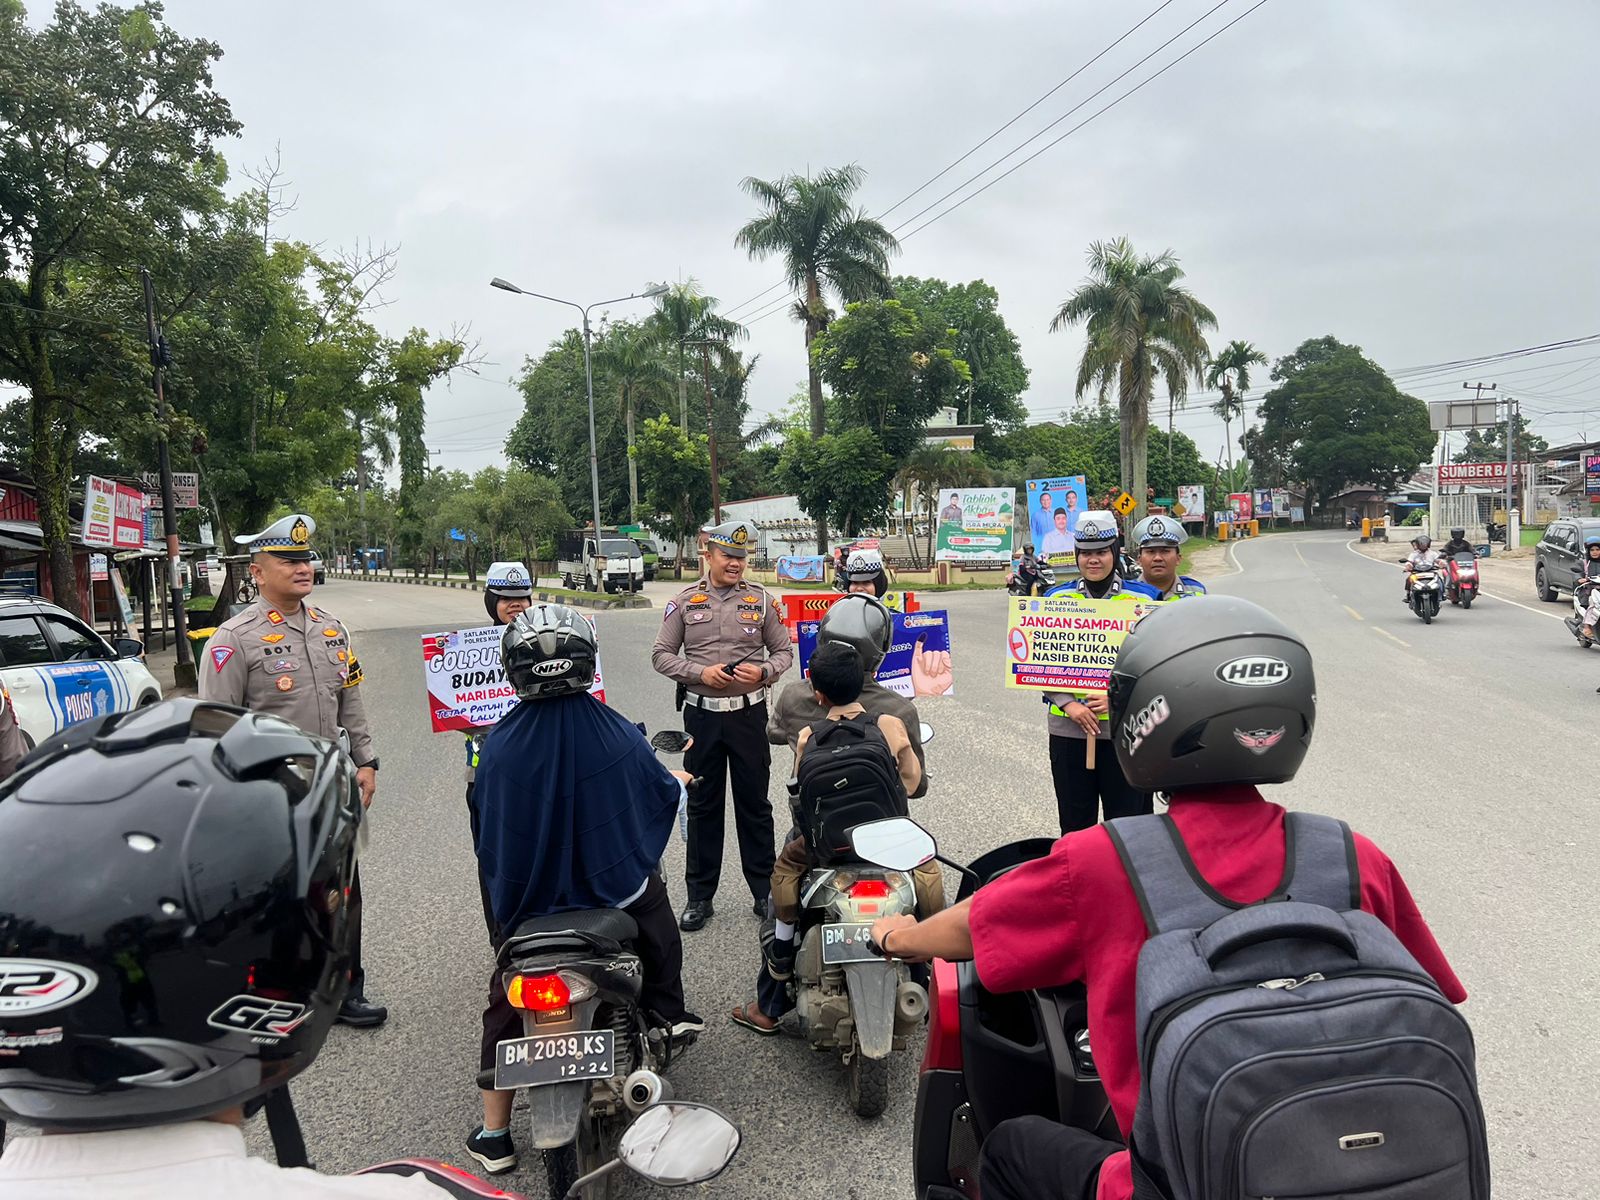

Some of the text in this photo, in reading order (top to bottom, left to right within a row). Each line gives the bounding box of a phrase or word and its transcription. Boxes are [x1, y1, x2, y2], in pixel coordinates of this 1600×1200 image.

[1441, 464, 1493, 478] SUMBER
[171, 475, 196, 487] ONSEL
[1041, 481, 1050, 491] 2
[737, 604, 762, 612] POLRI
[1020, 616, 1072, 629] JANGAN
[1074, 619, 1123, 631] SAMPAI
[464, 629, 499, 638] SATLANTAS
[1033, 630, 1107, 643] SUARO KITO
[464, 637, 488, 645] POLRES
[892, 642, 912, 653] 2024
[264, 645, 292, 655] BOY
[1033, 642, 1119, 654] MENENTUKAN
[1032, 652, 1115, 665] NASIB BANGS
[452, 669, 508, 689] BUDAY
[1021, 675, 1107, 688] CERMIN BUDAYA BANGSA
[456, 690, 487, 703] MARI
[65, 692, 94, 723] POLISI
[437, 708, 467, 718] TETAP
[470, 702, 503, 714] PATUHI
[470, 712, 496, 723] LALU
[826, 929, 845, 945] BM
[505, 1035, 605, 1065] BM 2039 KS
